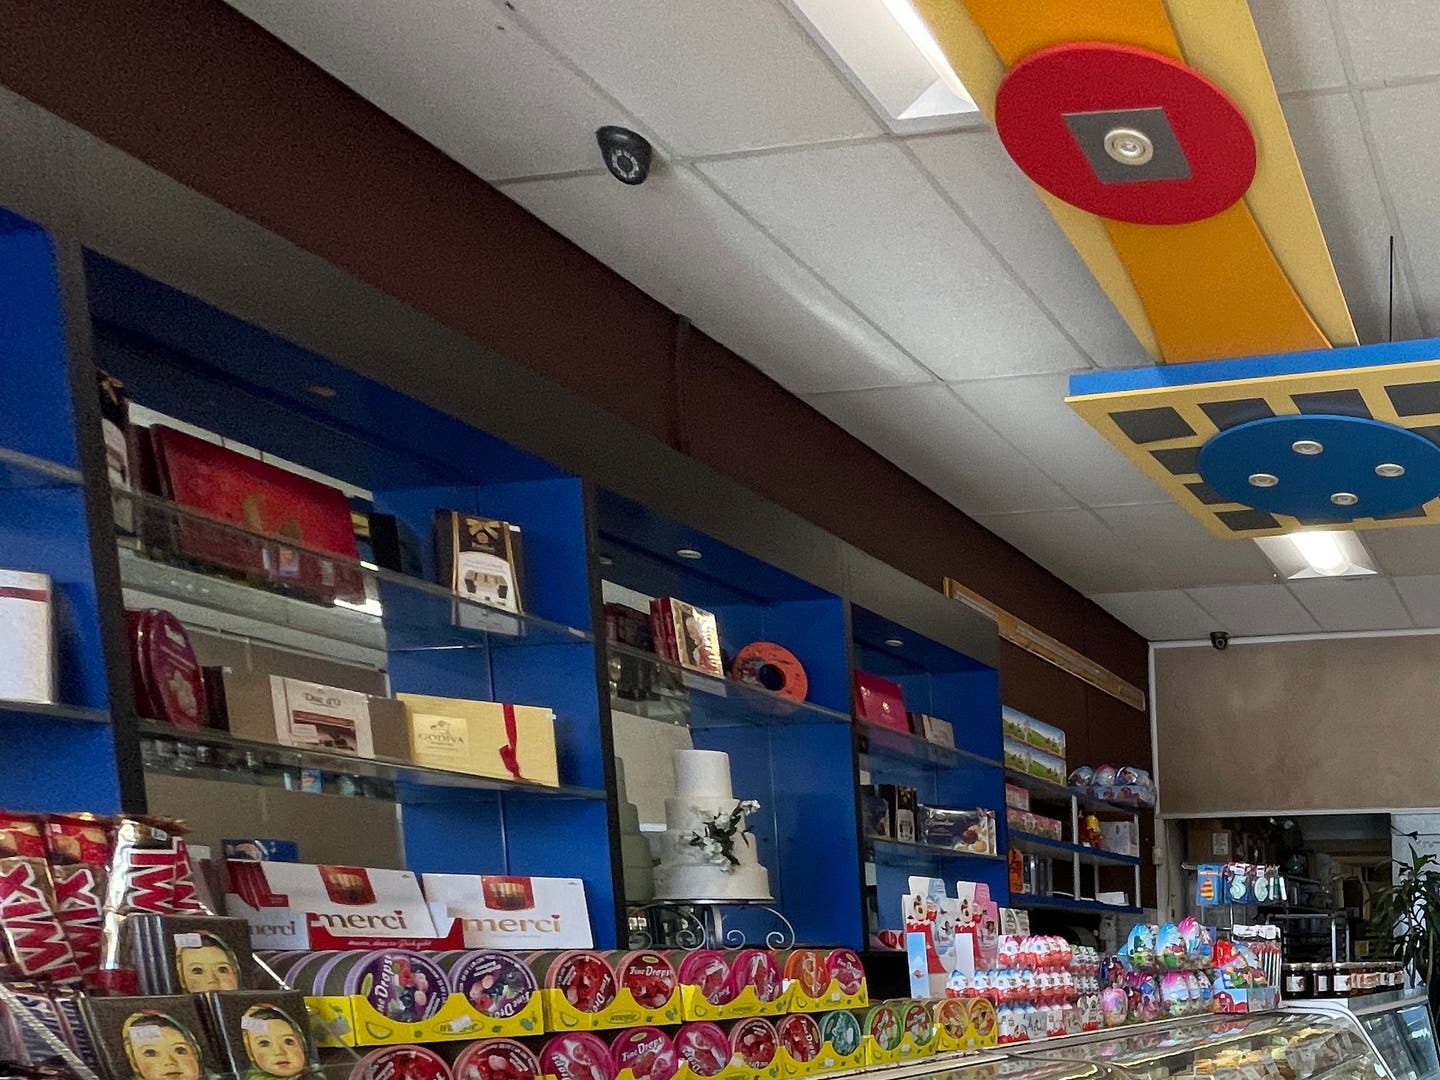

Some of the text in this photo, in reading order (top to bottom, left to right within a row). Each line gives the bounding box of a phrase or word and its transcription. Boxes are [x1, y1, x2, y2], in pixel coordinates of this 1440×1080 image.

[418, 732, 464, 745] GODIVA
[318, 910, 408, 930] merci
[463, 913, 561, 934] merci
[645, 965, 672, 978] Drops
